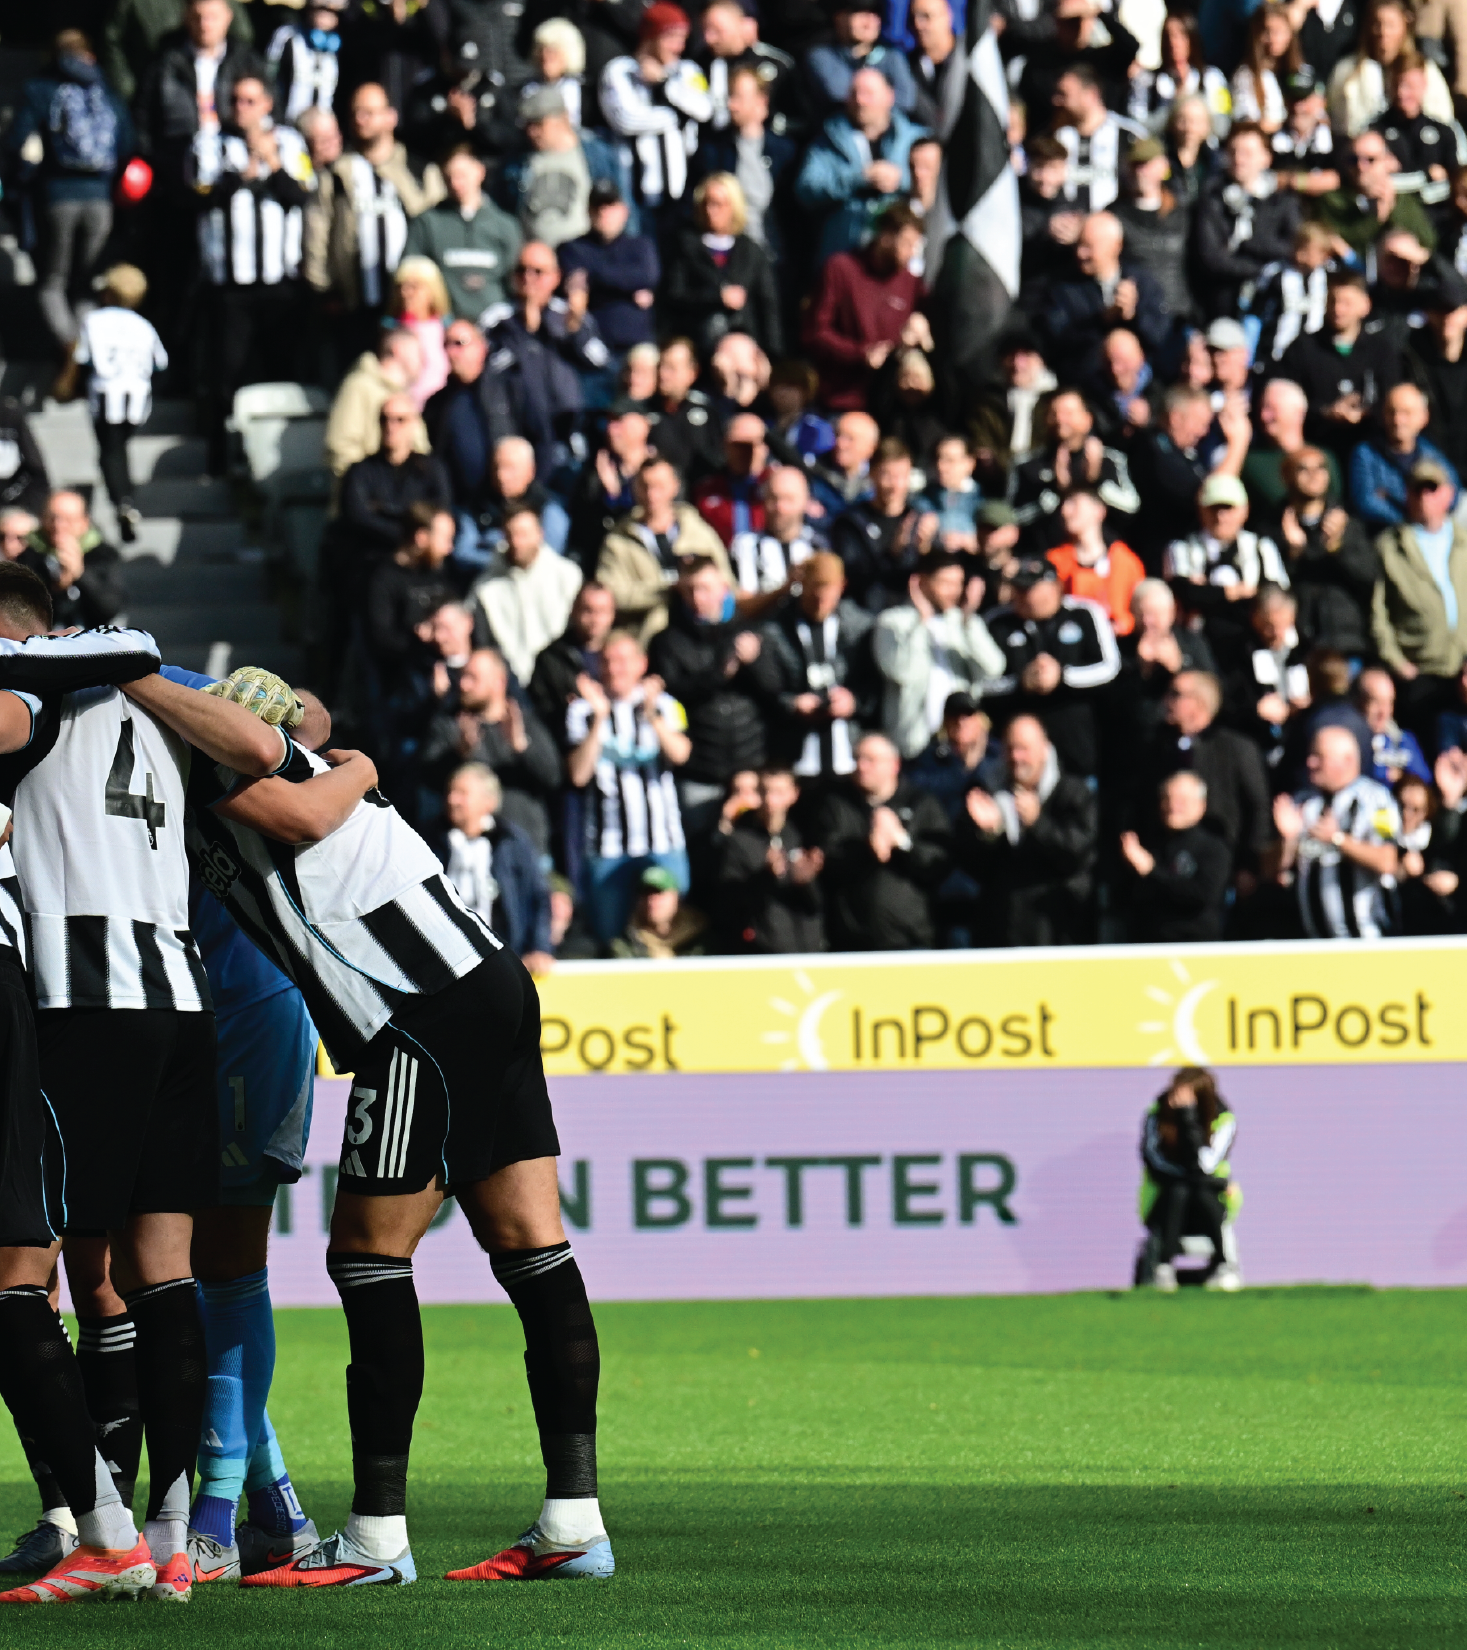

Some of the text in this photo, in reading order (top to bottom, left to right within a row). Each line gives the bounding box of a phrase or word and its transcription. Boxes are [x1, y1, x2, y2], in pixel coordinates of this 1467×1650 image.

[105, 717, 165, 850] 4
[540, 1013, 681, 1072] Post
[852, 1003, 1056, 1060] InPost
[1230, 992, 1433, 1052] InPost
[228, 1076, 245, 1131] 1
[347, 1086, 378, 1145] 3
[632, 1152, 1020, 1231] BETTER
